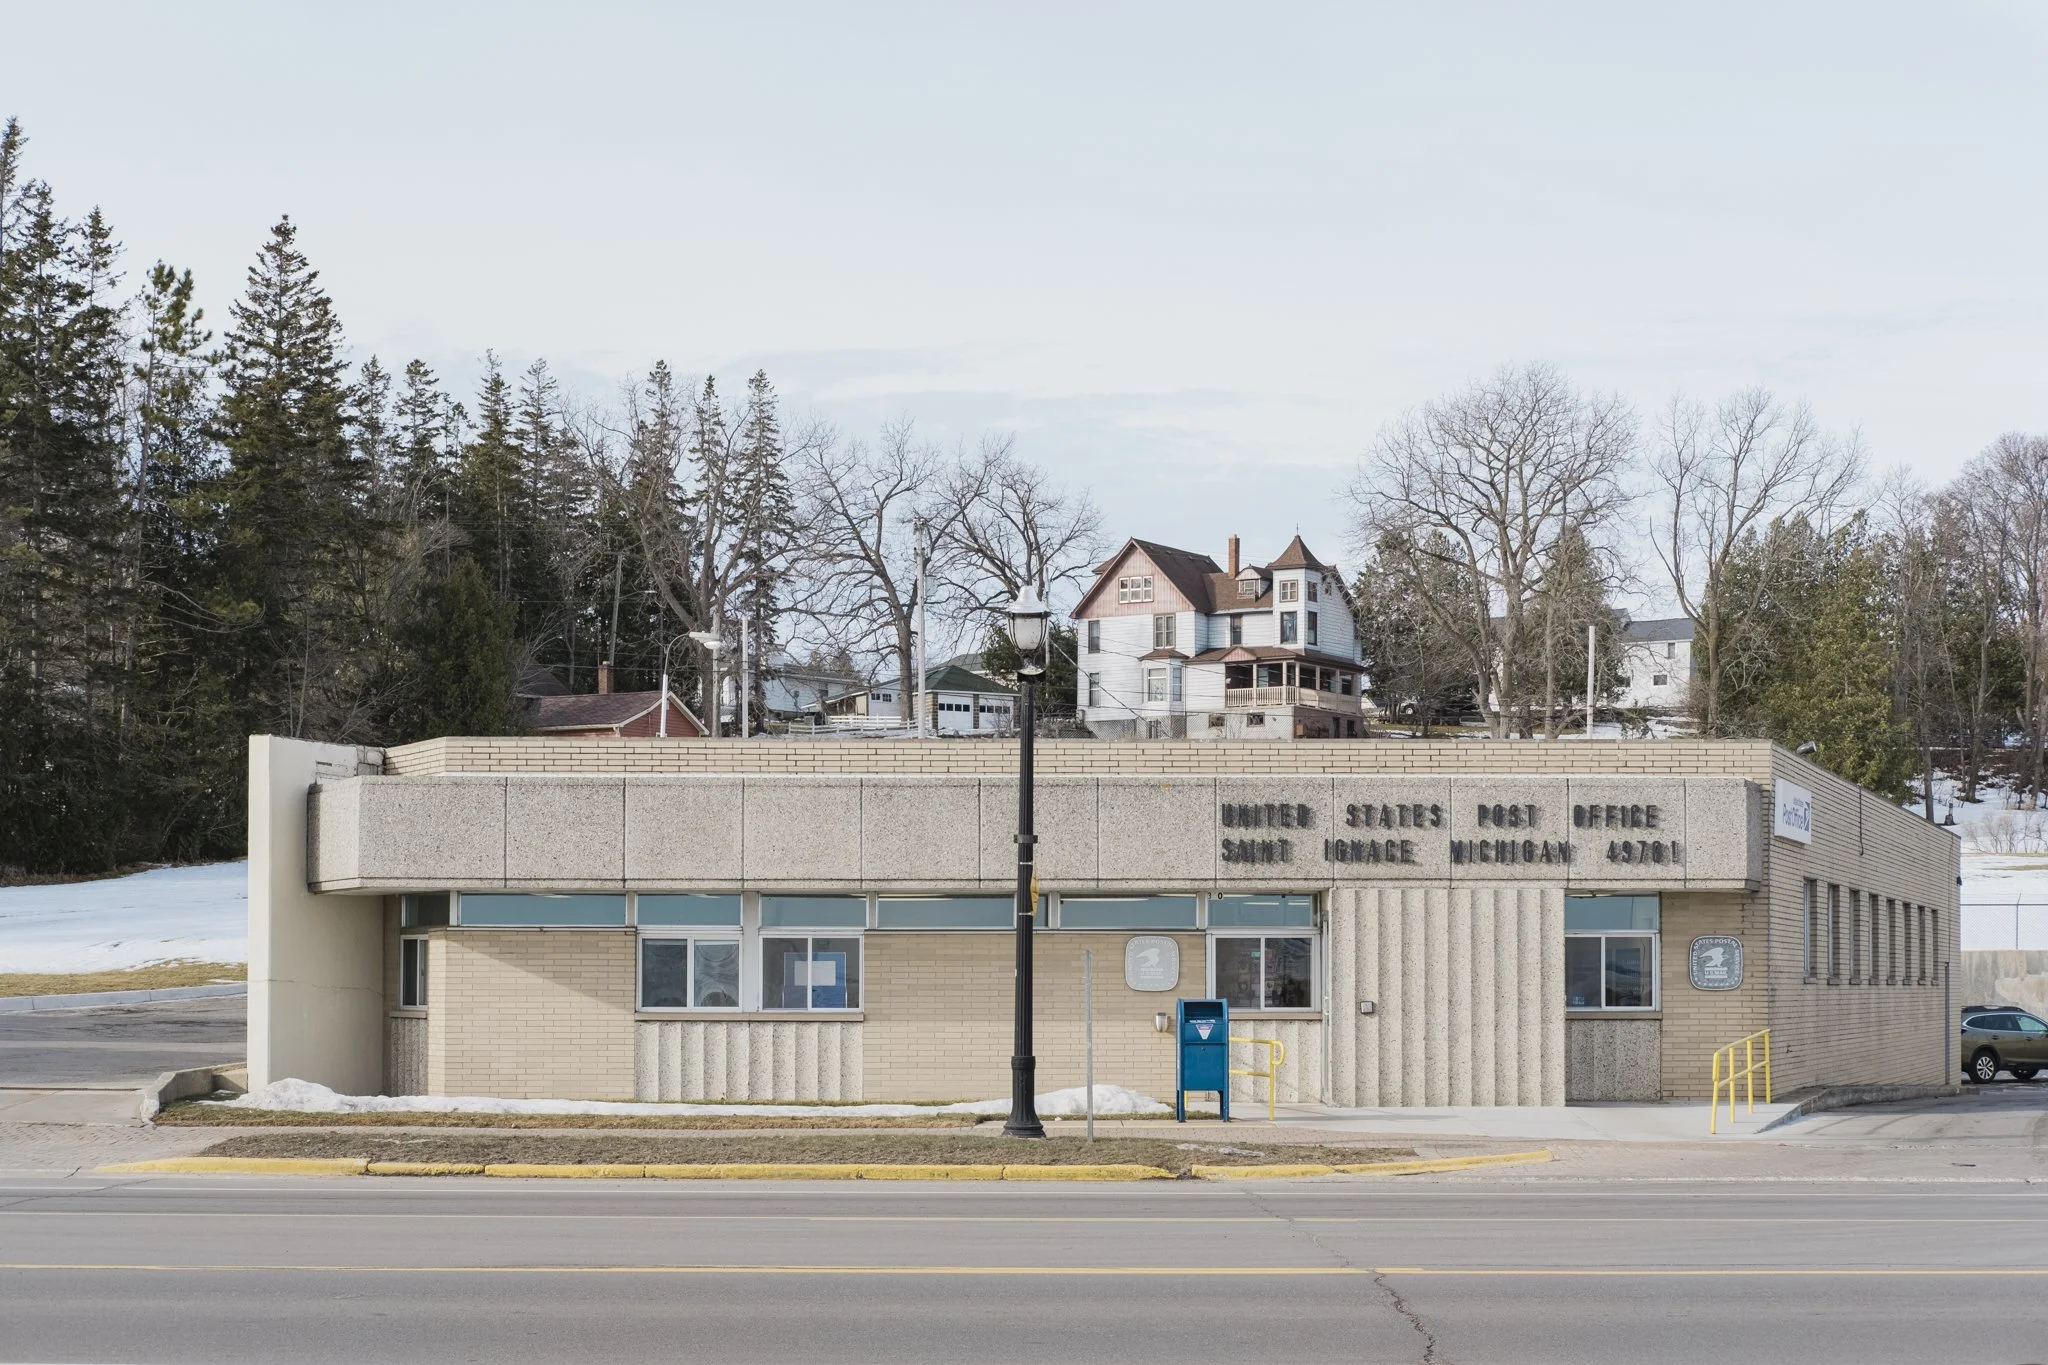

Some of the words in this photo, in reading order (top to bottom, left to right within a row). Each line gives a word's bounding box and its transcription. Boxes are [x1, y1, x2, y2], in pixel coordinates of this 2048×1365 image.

[1221, 803, 1310, 827] UNITED
[1346, 803, 1442, 827] STATES
[1477, 804, 1536, 827] POST
[1573, 804, 1658, 828] OFFICE
[1221, 838, 1289, 862] SAINT
[1324, 838, 1415, 863] IGNACE
[1450, 839, 1572, 864] MICHIGAN
[1606, 840, 1680, 864] 49781
[1693, 938, 1714, 949] STATES
[1714, 938, 1738, 948] POSTAL
